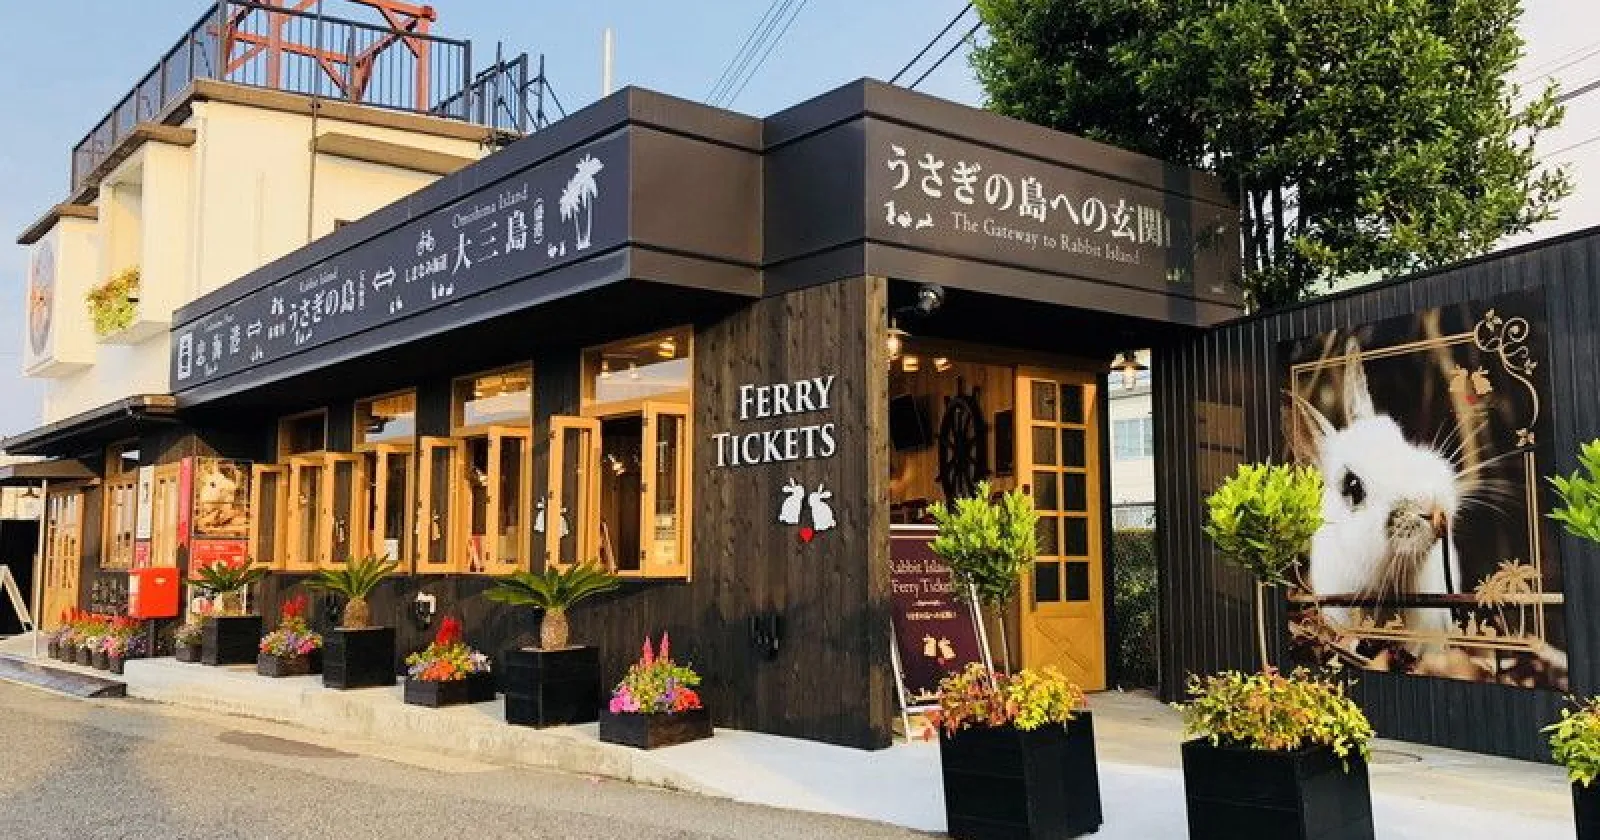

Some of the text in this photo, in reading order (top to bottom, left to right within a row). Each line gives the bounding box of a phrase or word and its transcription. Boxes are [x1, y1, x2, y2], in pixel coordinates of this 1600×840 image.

[452, 210, 528, 274] 大三島
[952, 211, 979, 233] The
[983, 218, 1039, 250] Gateway
[1043, 236, 1057, 250] to
[1061, 234, 1101, 257] Rabbit
[739, 375, 835, 421] FERRY
[711, 424, 836, 467] TICKETS
